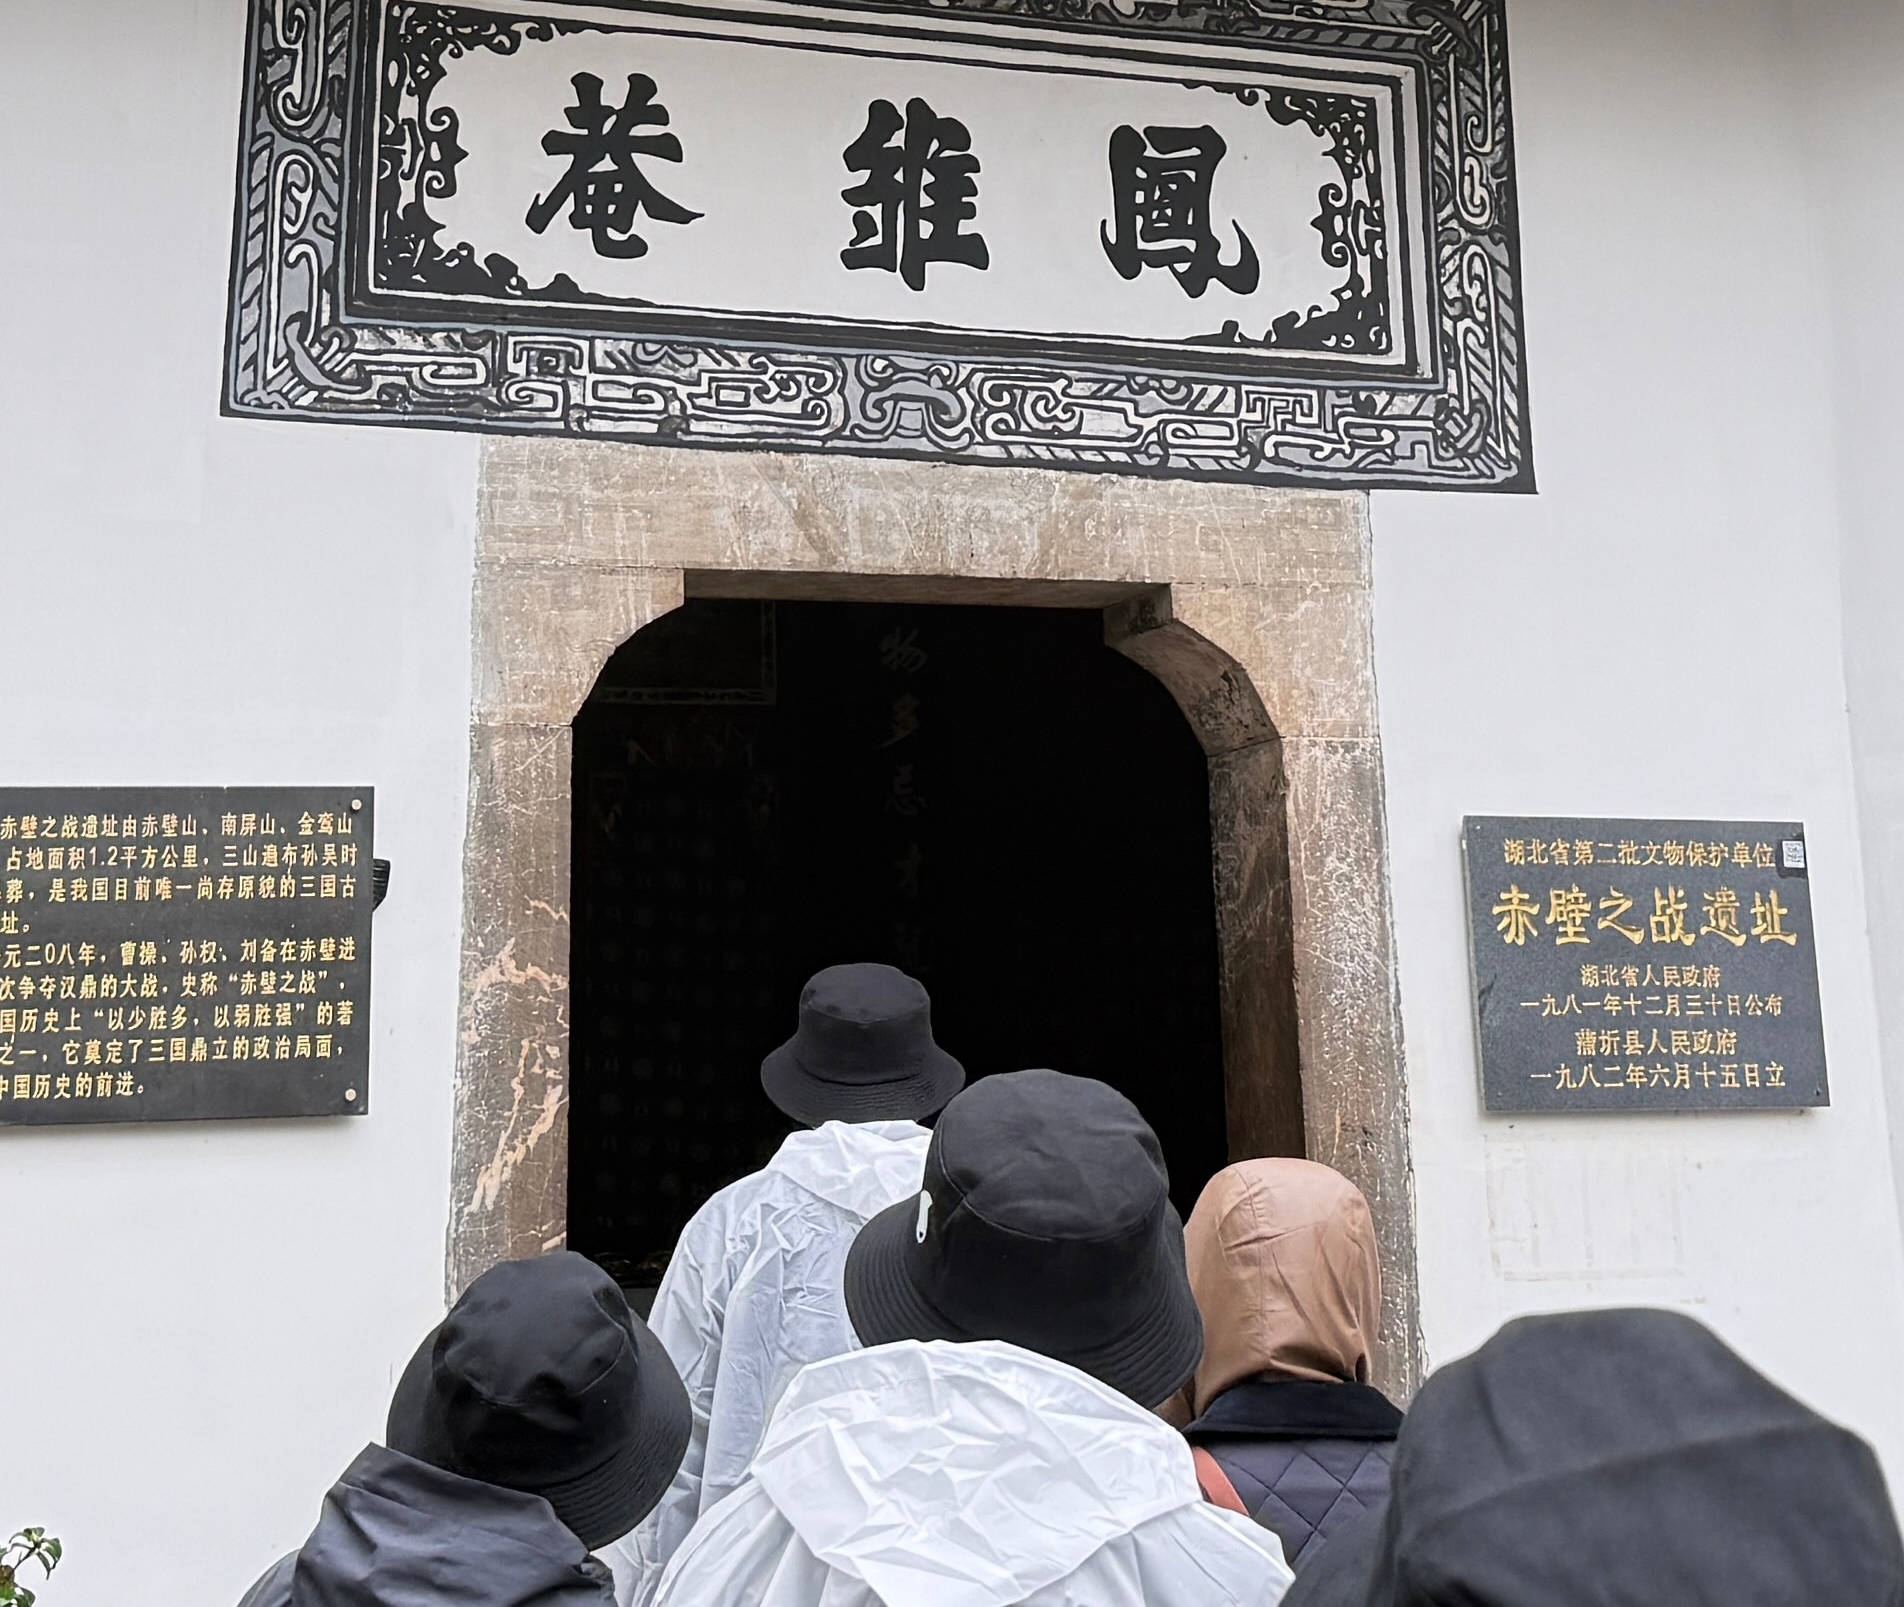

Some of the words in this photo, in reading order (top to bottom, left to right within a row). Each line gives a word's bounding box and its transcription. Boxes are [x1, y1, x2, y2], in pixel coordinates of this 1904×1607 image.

[1504, 838, 1776, 868] 湖北省第二批文物保护单位
[1492, 884, 1798, 946] 赤壁之战遗址
[1580, 964, 1722, 987] 湖北省人民政府
[1520, 994, 1782, 1017] 一九八一年十二月三十日公布
[1575, 1028, 1738, 1056] 蒲圻县人民政府
[1530, 1061, 1786, 1089] 一九八二年六月十五日立
